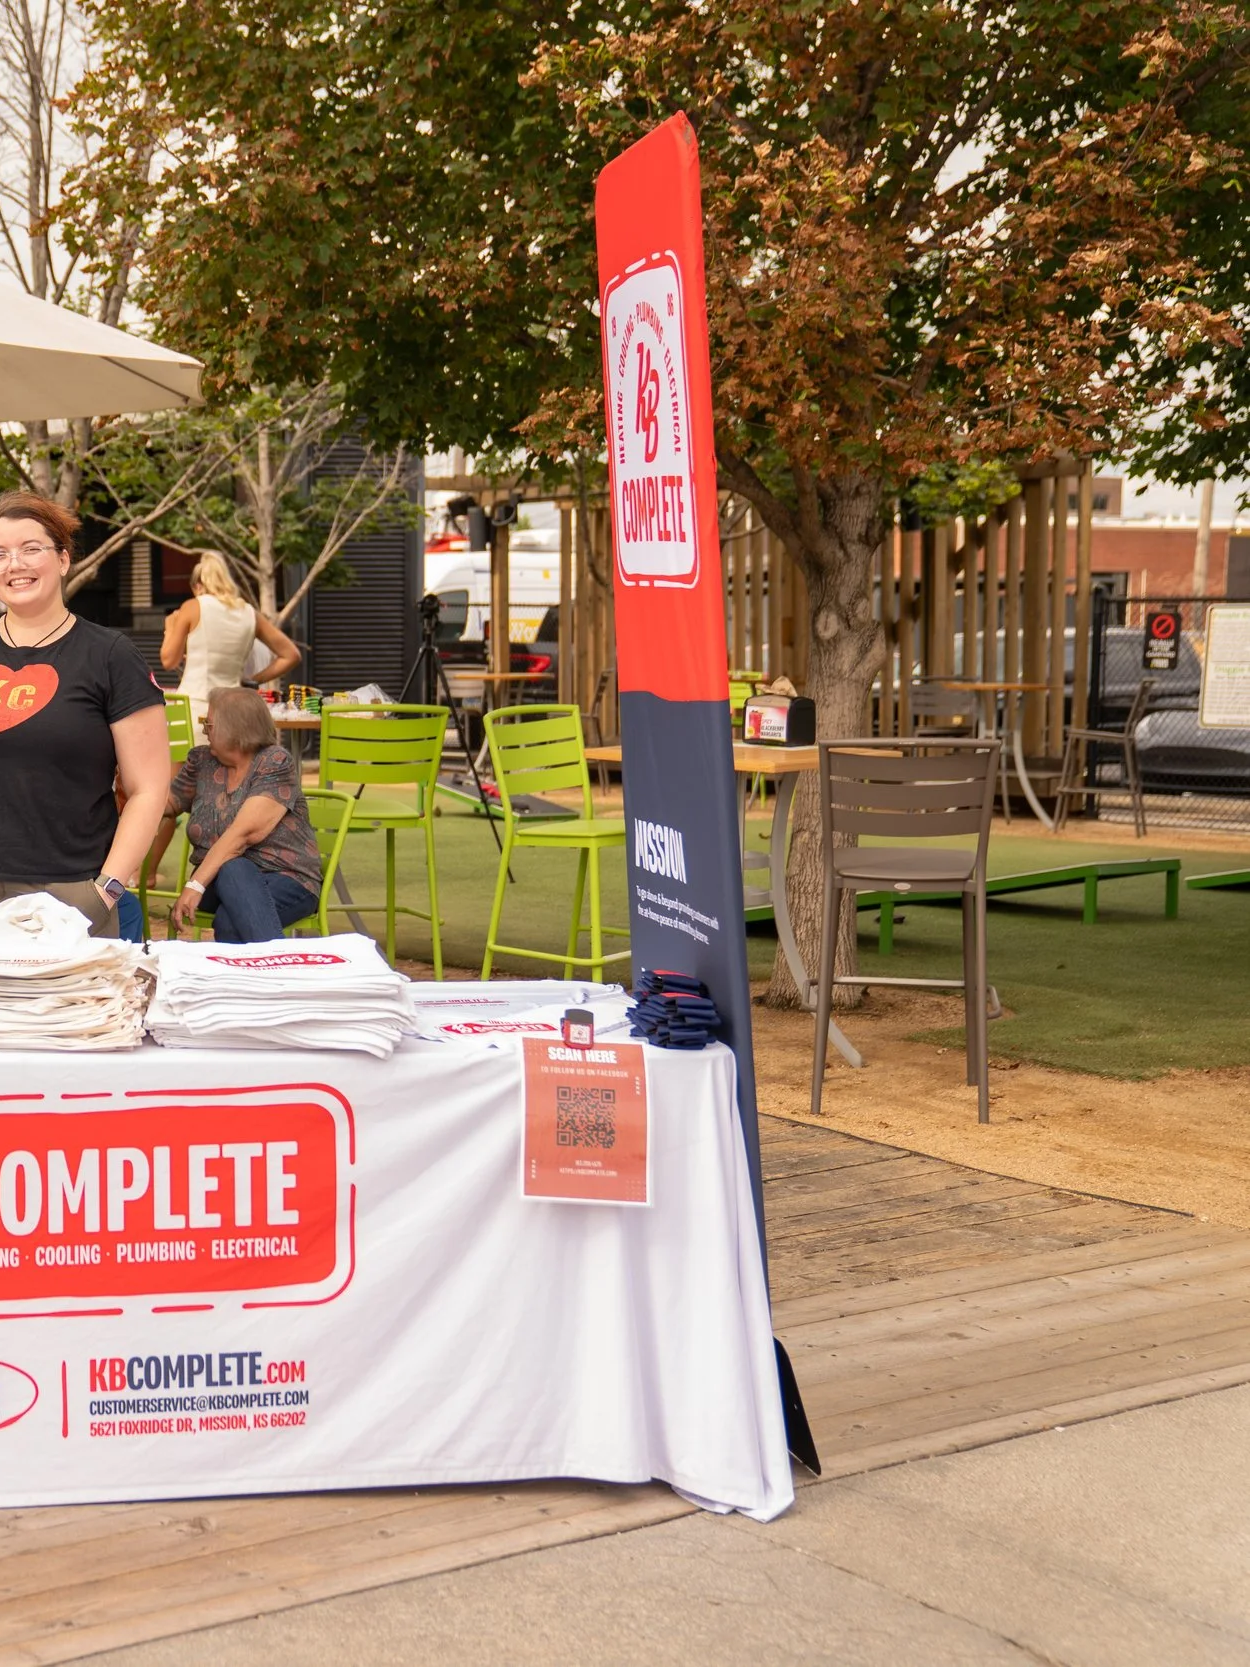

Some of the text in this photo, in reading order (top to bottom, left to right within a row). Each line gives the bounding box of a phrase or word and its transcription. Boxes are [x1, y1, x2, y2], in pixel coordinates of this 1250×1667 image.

[617, 302, 682, 465] HEATING COOLING PLUMBING ELECTRICAL
[636, 342, 660, 463] KB
[622, 475, 687, 543] COMPLETE
[635, 817, 687, 884] MISSION
[548, 1047, 617, 1064] SCAN HERE
[576, 1068, 586, 1076] US
[597, 1069, 629, 1078] FACEBOOK
[35, 1243, 101, 1267] COOLING
[116, 1240, 196, 1264] PLUMBING
[211, 1236, 298, 1260] ELECTRICAL
[89, 1351, 305, 1392] KBCOMPLETE.COM
[89, 1390, 309, 1416] CUSTOMERSERVICE@KBCOMPLETE.COM
[90, 1411, 306, 1438] 5621 FOXRIDGE DR, MISSION, KS 66202
